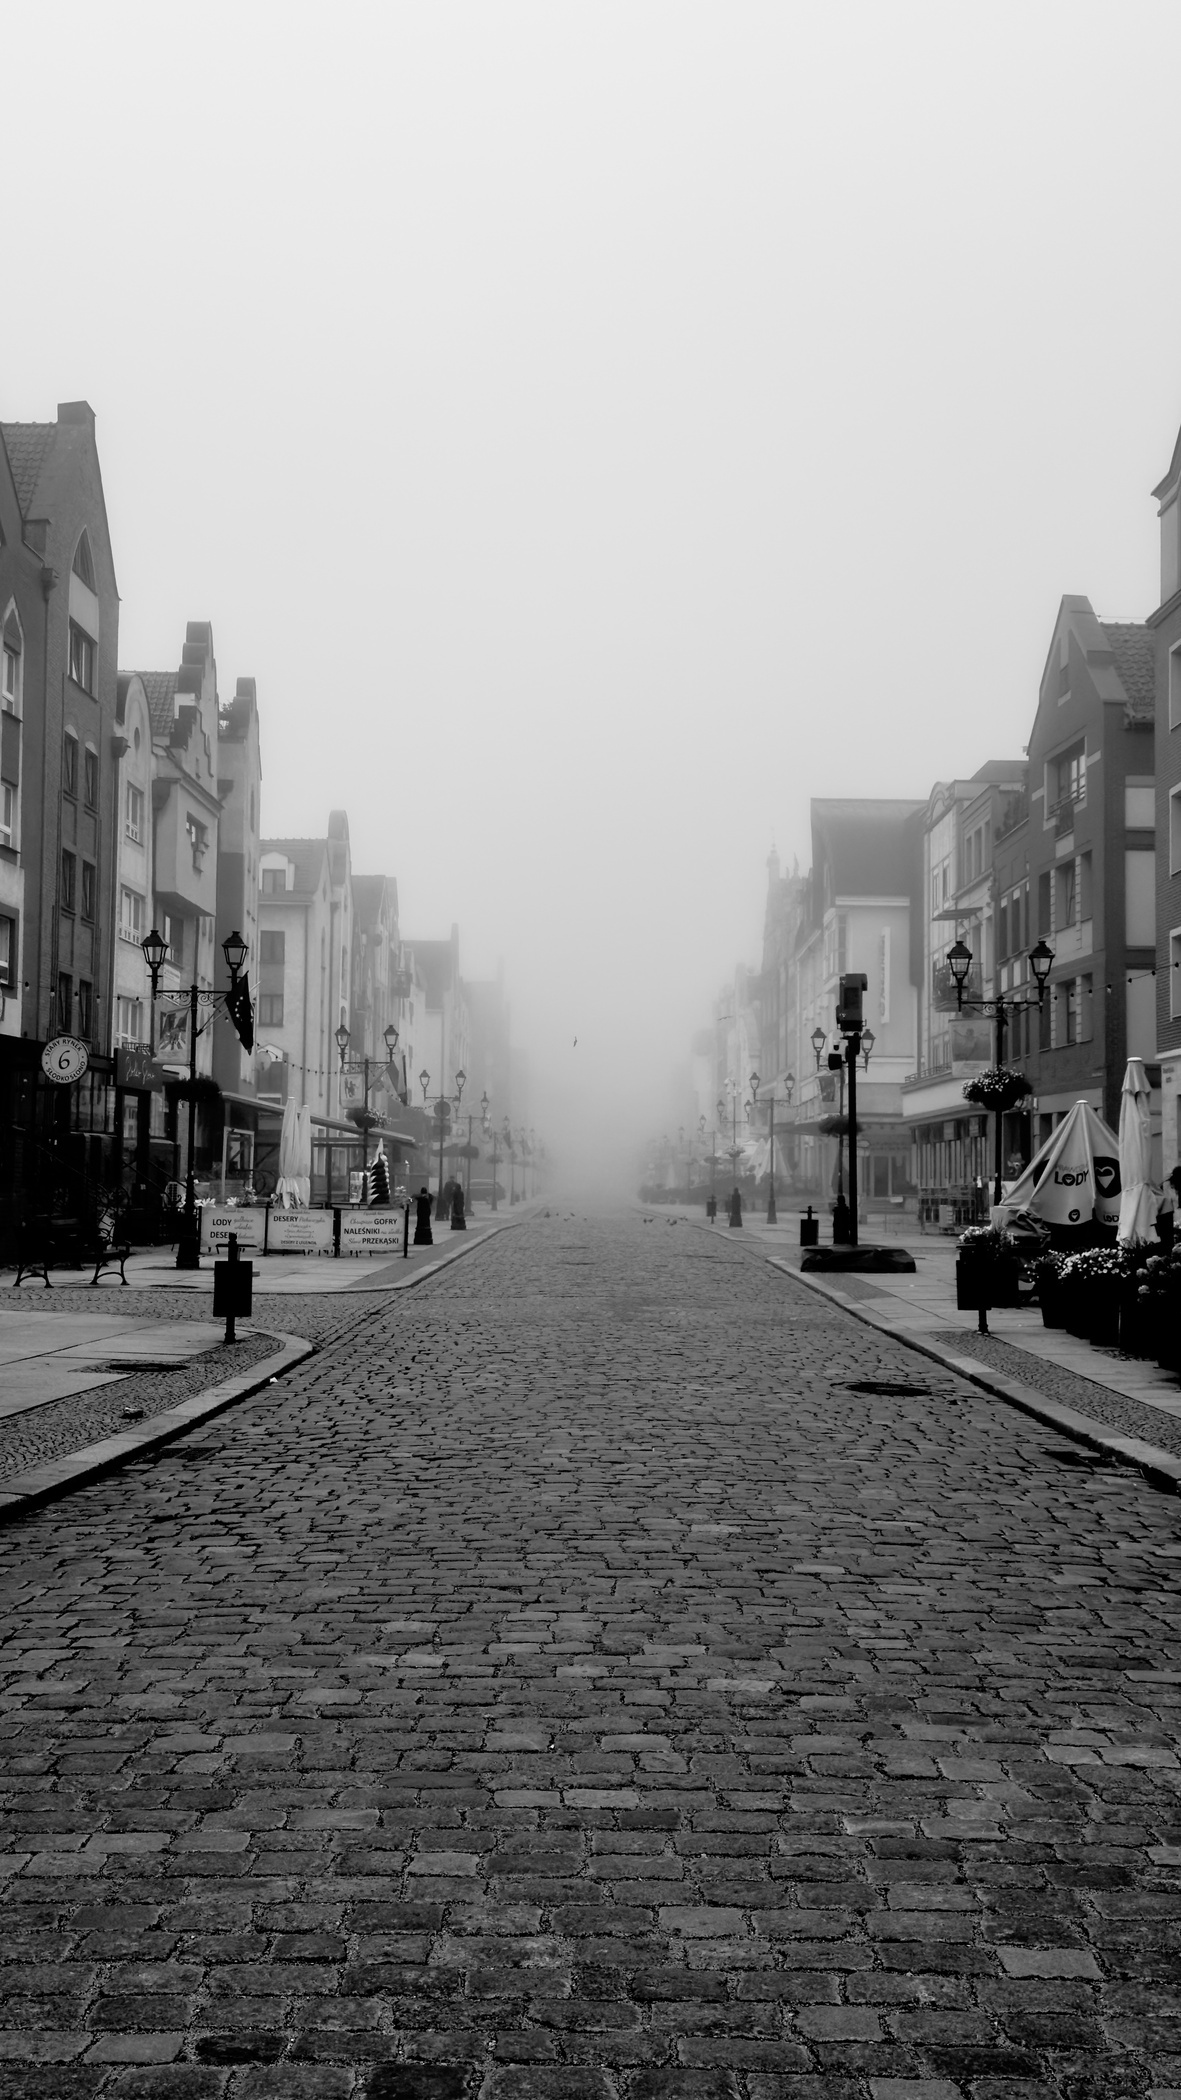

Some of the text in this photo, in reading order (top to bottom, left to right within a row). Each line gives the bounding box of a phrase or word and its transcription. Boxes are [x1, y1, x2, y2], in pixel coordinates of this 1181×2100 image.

[44, 1038, 83, 1057] STARY RYNEK
[58, 1050, 70, 1070] 6
[1054, 1168, 1089, 1187] LODY
[212, 1218, 232, 1226] LODY
[1103, 1214, 1120, 1223] LOD
[343, 1227, 380, 1235] NALEŚNIKI
[362, 1237, 399, 1246] PRZEKĄSKI
